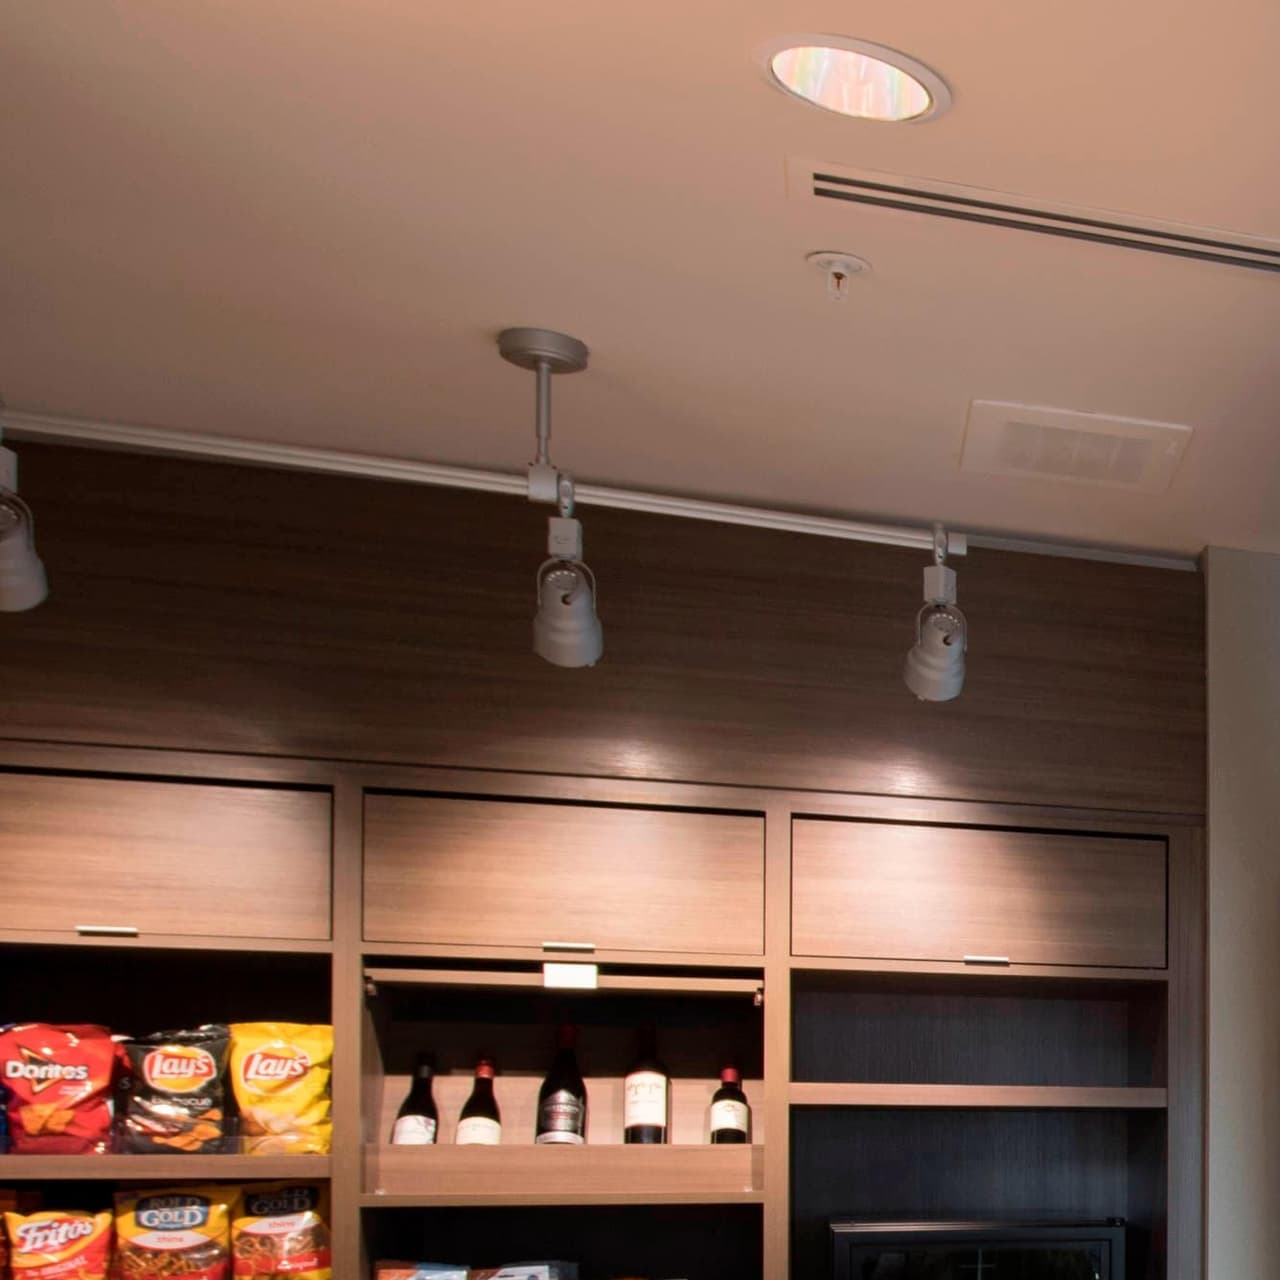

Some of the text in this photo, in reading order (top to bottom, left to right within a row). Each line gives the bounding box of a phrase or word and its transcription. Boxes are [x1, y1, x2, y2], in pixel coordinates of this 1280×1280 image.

[5, 1060, 88, 1080] Doritos
[151, 1053, 210, 1079] Lay's
[247, 1053, 311, 1080] Lay's
[141, 1209, 203, 1228] GOLD
[16, 1220, 93, 1254] Fritos
